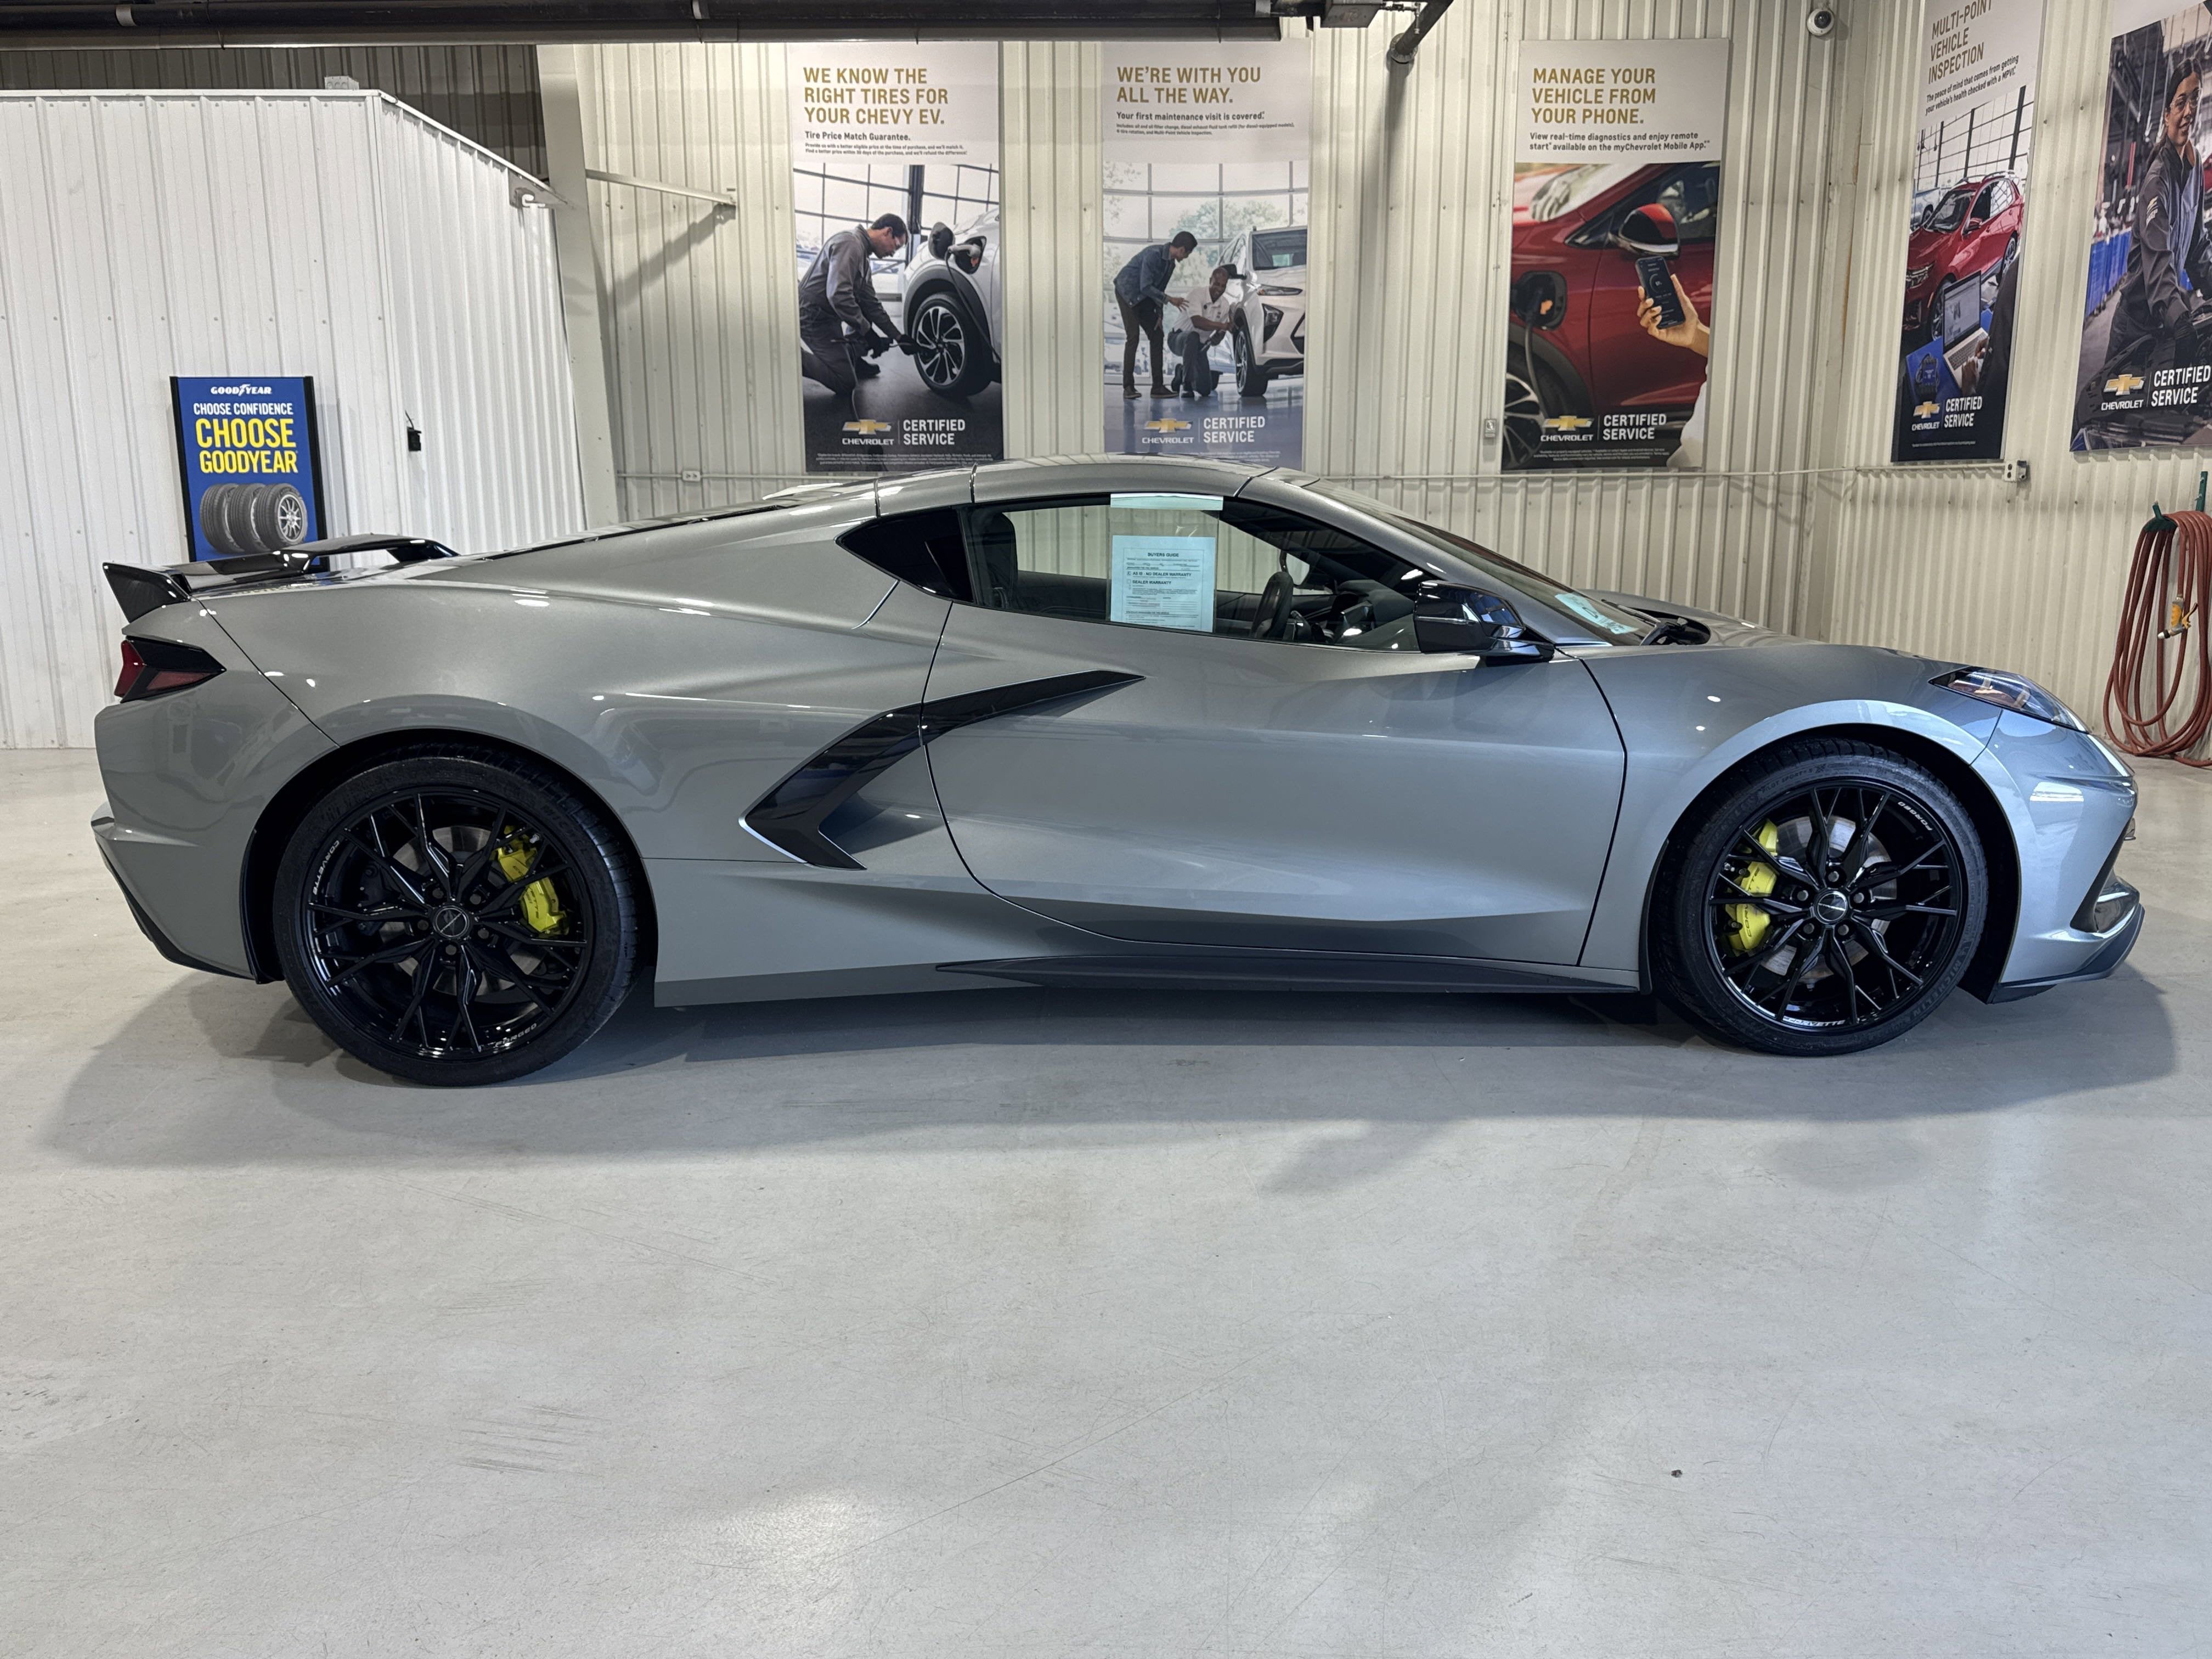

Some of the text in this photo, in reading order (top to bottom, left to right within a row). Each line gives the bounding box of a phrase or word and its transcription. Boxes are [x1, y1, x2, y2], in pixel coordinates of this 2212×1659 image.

[1931, 27, 1970, 61] VEHICLE
[1928, 41, 1984, 84] INSPECTION
[1963, 75, 1973, 86] that
[1973, 70, 1988, 82] comes
[2001, 55, 2019, 71] getting
[803, 67, 927, 84] WE KNOW THE
[1117, 66, 1261, 83] WE'RE WITH YOU
[1533, 67, 1655, 84] MANAGE YOUR
[804, 87, 948, 104] RIGHT TIRES FOR
[1116, 87, 1233, 103] ALL THE WAY.
[1532, 88, 1656, 104] VEHICLE FROM
[1953, 88, 1967, 101] health
[1967, 80, 1987, 96] checked
[1987, 75, 1997, 87] with
[804, 107, 945, 125] YOUR CHEVY EV.
[1116, 111, 1134, 120] Your
[1136, 112, 1153, 120] first
[1531, 108, 1644, 123] YOUR PHONE.
[805, 131, 911, 141] Tire Price Match Guarantee.
[1530, 132, 1548, 140] View
[1588, 133, 1631, 143] diagnostics
[1649, 132, 1669, 142] enjoy
[1553, 143, 1585, 151] available
[1613, 143, 1662, 153] myChevrolet
[2153, 365, 2211, 387] CERTIFIED
[210, 383, 272, 396] GOODYEAR
[2151, 386, 2199, 407] SERVICE
[193, 403, 294, 415] CHOOSE CONFIDENCE
[1945, 396, 1983, 413] CERTIFIED
[2101, 399, 2144, 411] CHEVROLET
[902, 419, 966, 432] CERTIFIED
[1203, 416, 1266, 430] CERTIFIED
[1603, 414, 1667, 427] CERTIFIED
[1911, 421, 1940, 431] CHEVROLET
[1944, 413, 1974, 428] SERVICE
[195, 417, 297, 448] CHOOSE
[902, 433, 955, 445] SERVICE
[1203, 430, 1255, 443] SERVICE
[1541, 434, 1594, 442] CHEVROLET
[1602, 427, 1655, 441] SERVICE
[199, 449, 298, 474] GOODYEAR
[1897, 801, 1933, 831] FORGED
[312, 839, 340, 896] CORVETTE
